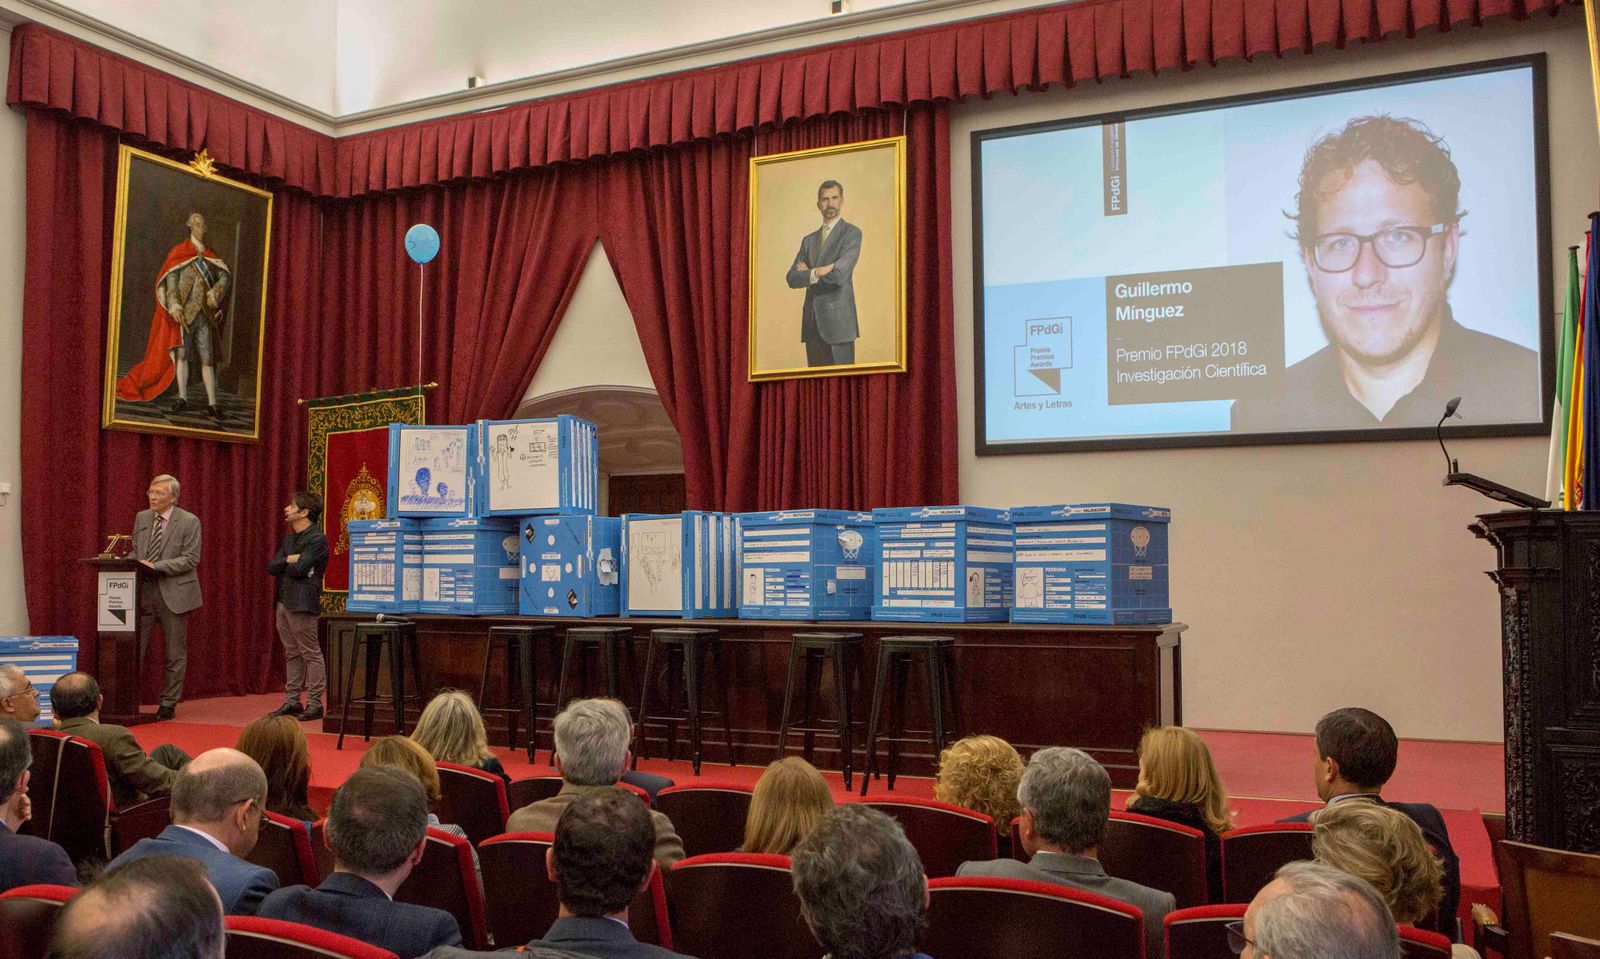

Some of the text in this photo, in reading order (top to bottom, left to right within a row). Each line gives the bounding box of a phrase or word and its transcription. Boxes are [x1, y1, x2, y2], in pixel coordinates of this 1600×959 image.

[1110, 176, 1121, 211] FPdGi
[1115, 281, 1193, 299] Guillermo
[1115, 304, 1185, 323] Mínguez
[1030, 323, 1063, 335] FPdGi
[1116, 340, 1247, 362] Premio FPdGi 2018
[1116, 361, 1267, 384] Investigación Científica
[1014, 400, 1073, 411] Artes y Letras
[109, 581, 129, 589] FPdGi
